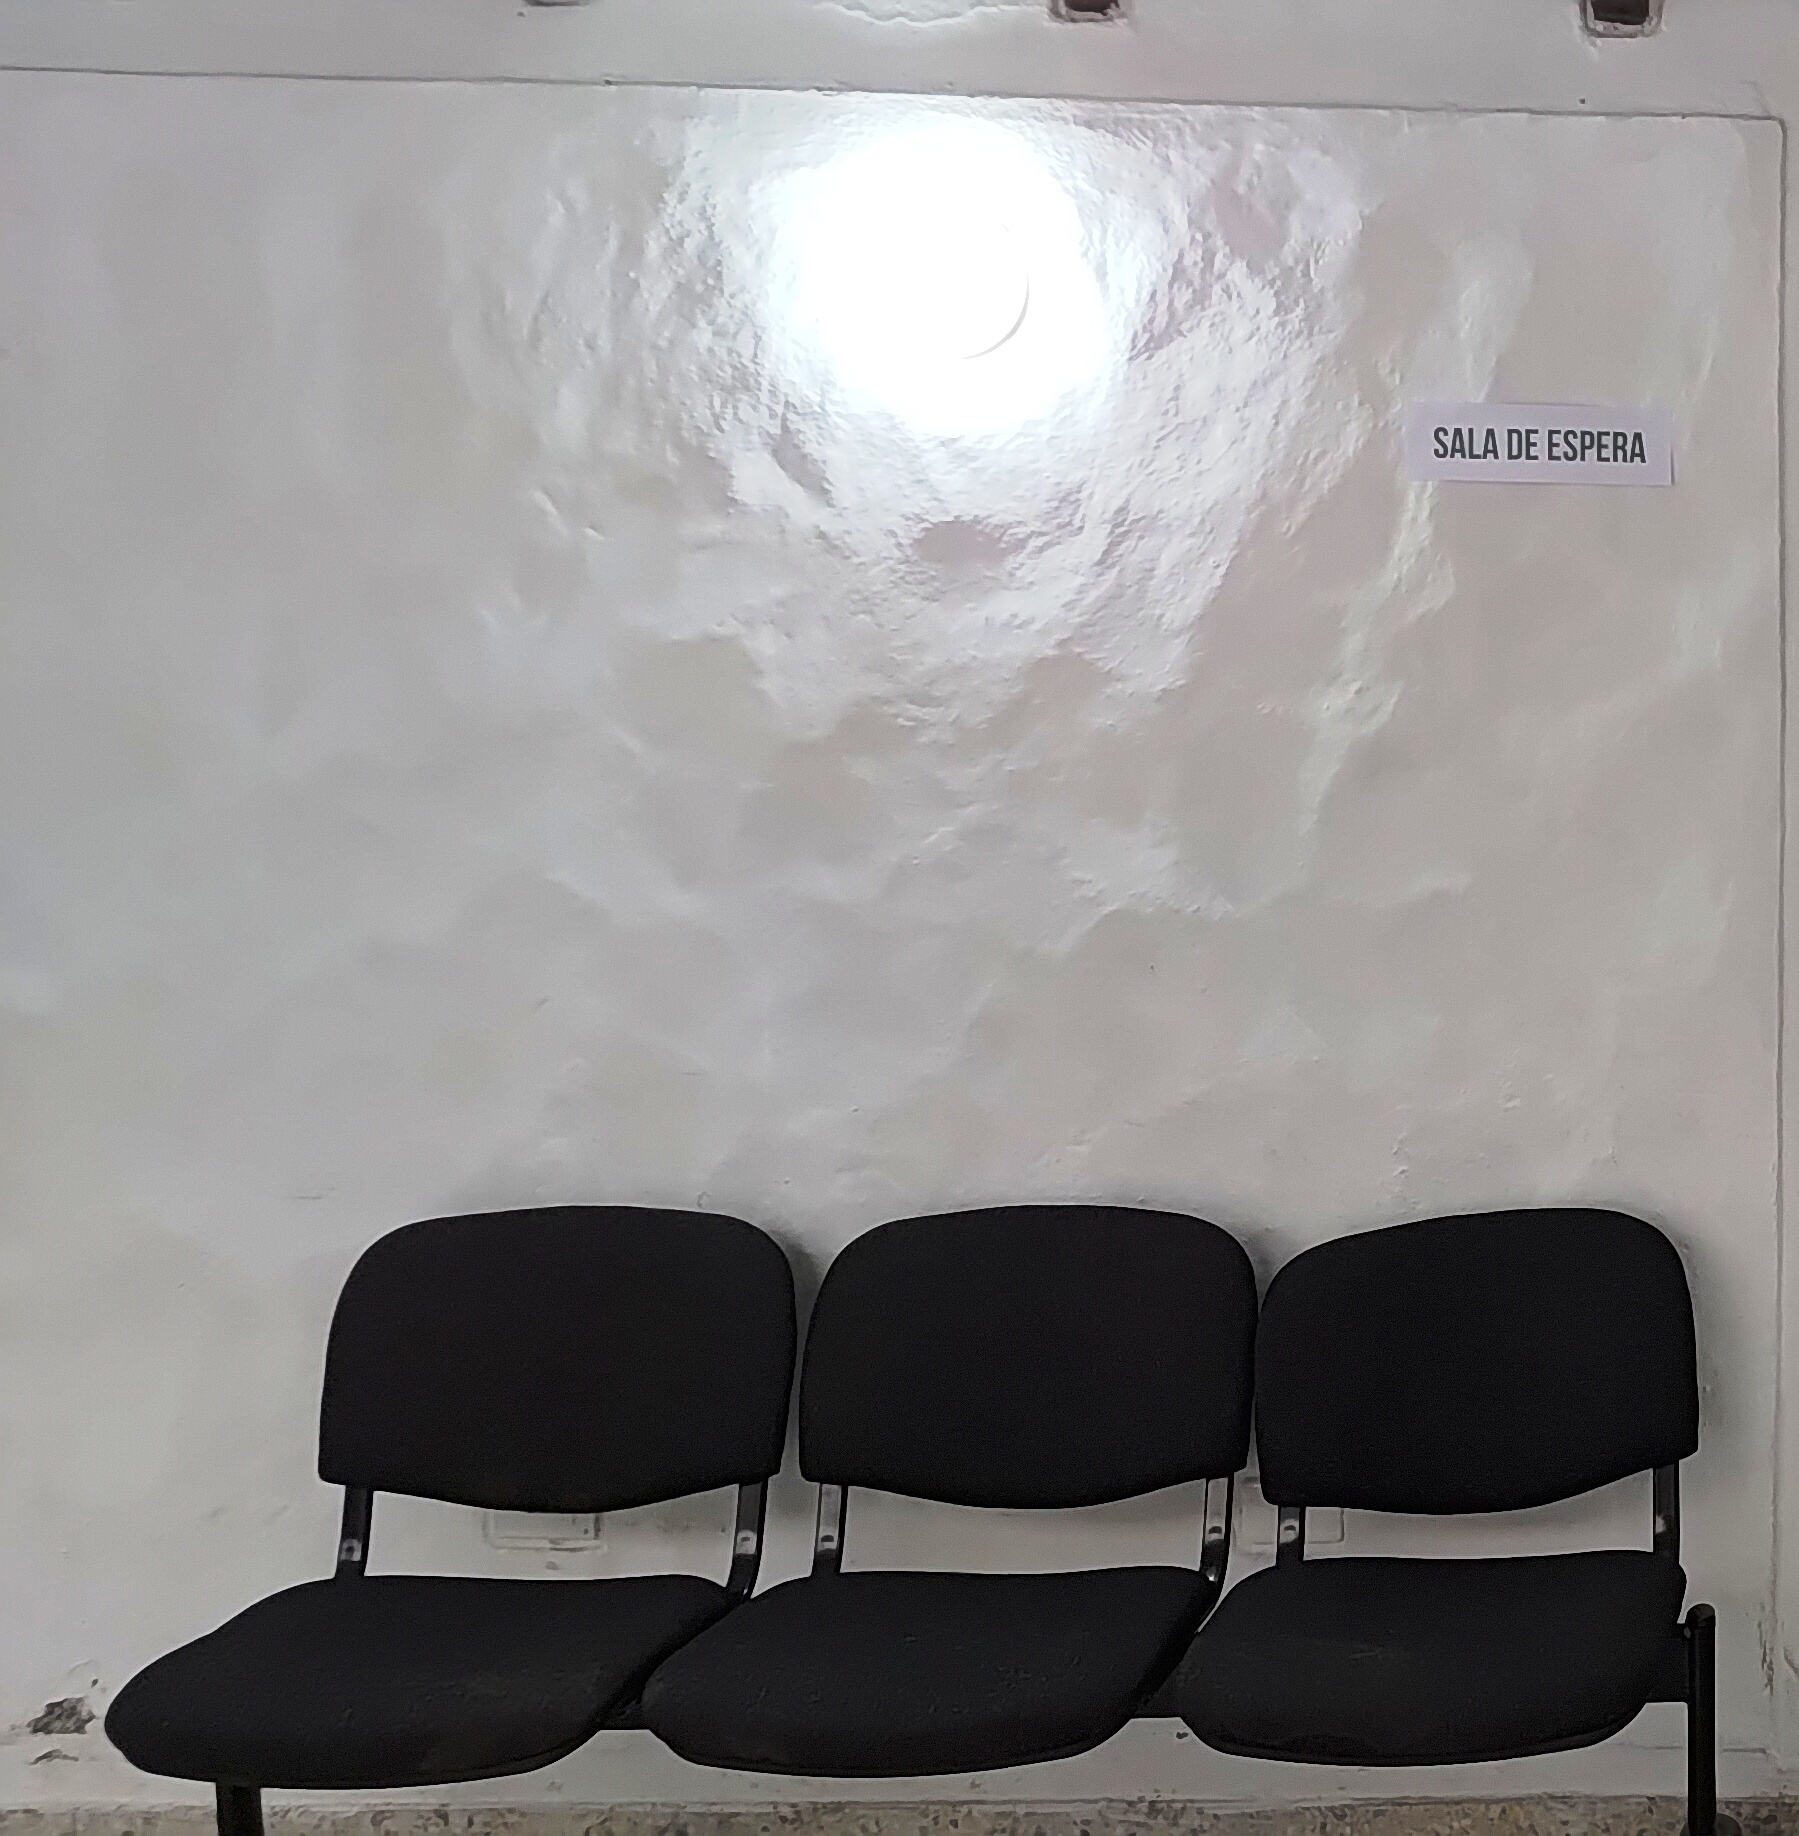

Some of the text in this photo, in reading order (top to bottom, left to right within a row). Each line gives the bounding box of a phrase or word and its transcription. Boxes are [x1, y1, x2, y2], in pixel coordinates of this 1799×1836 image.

[1433, 426, 1647, 464] SALA DE ESPERA
